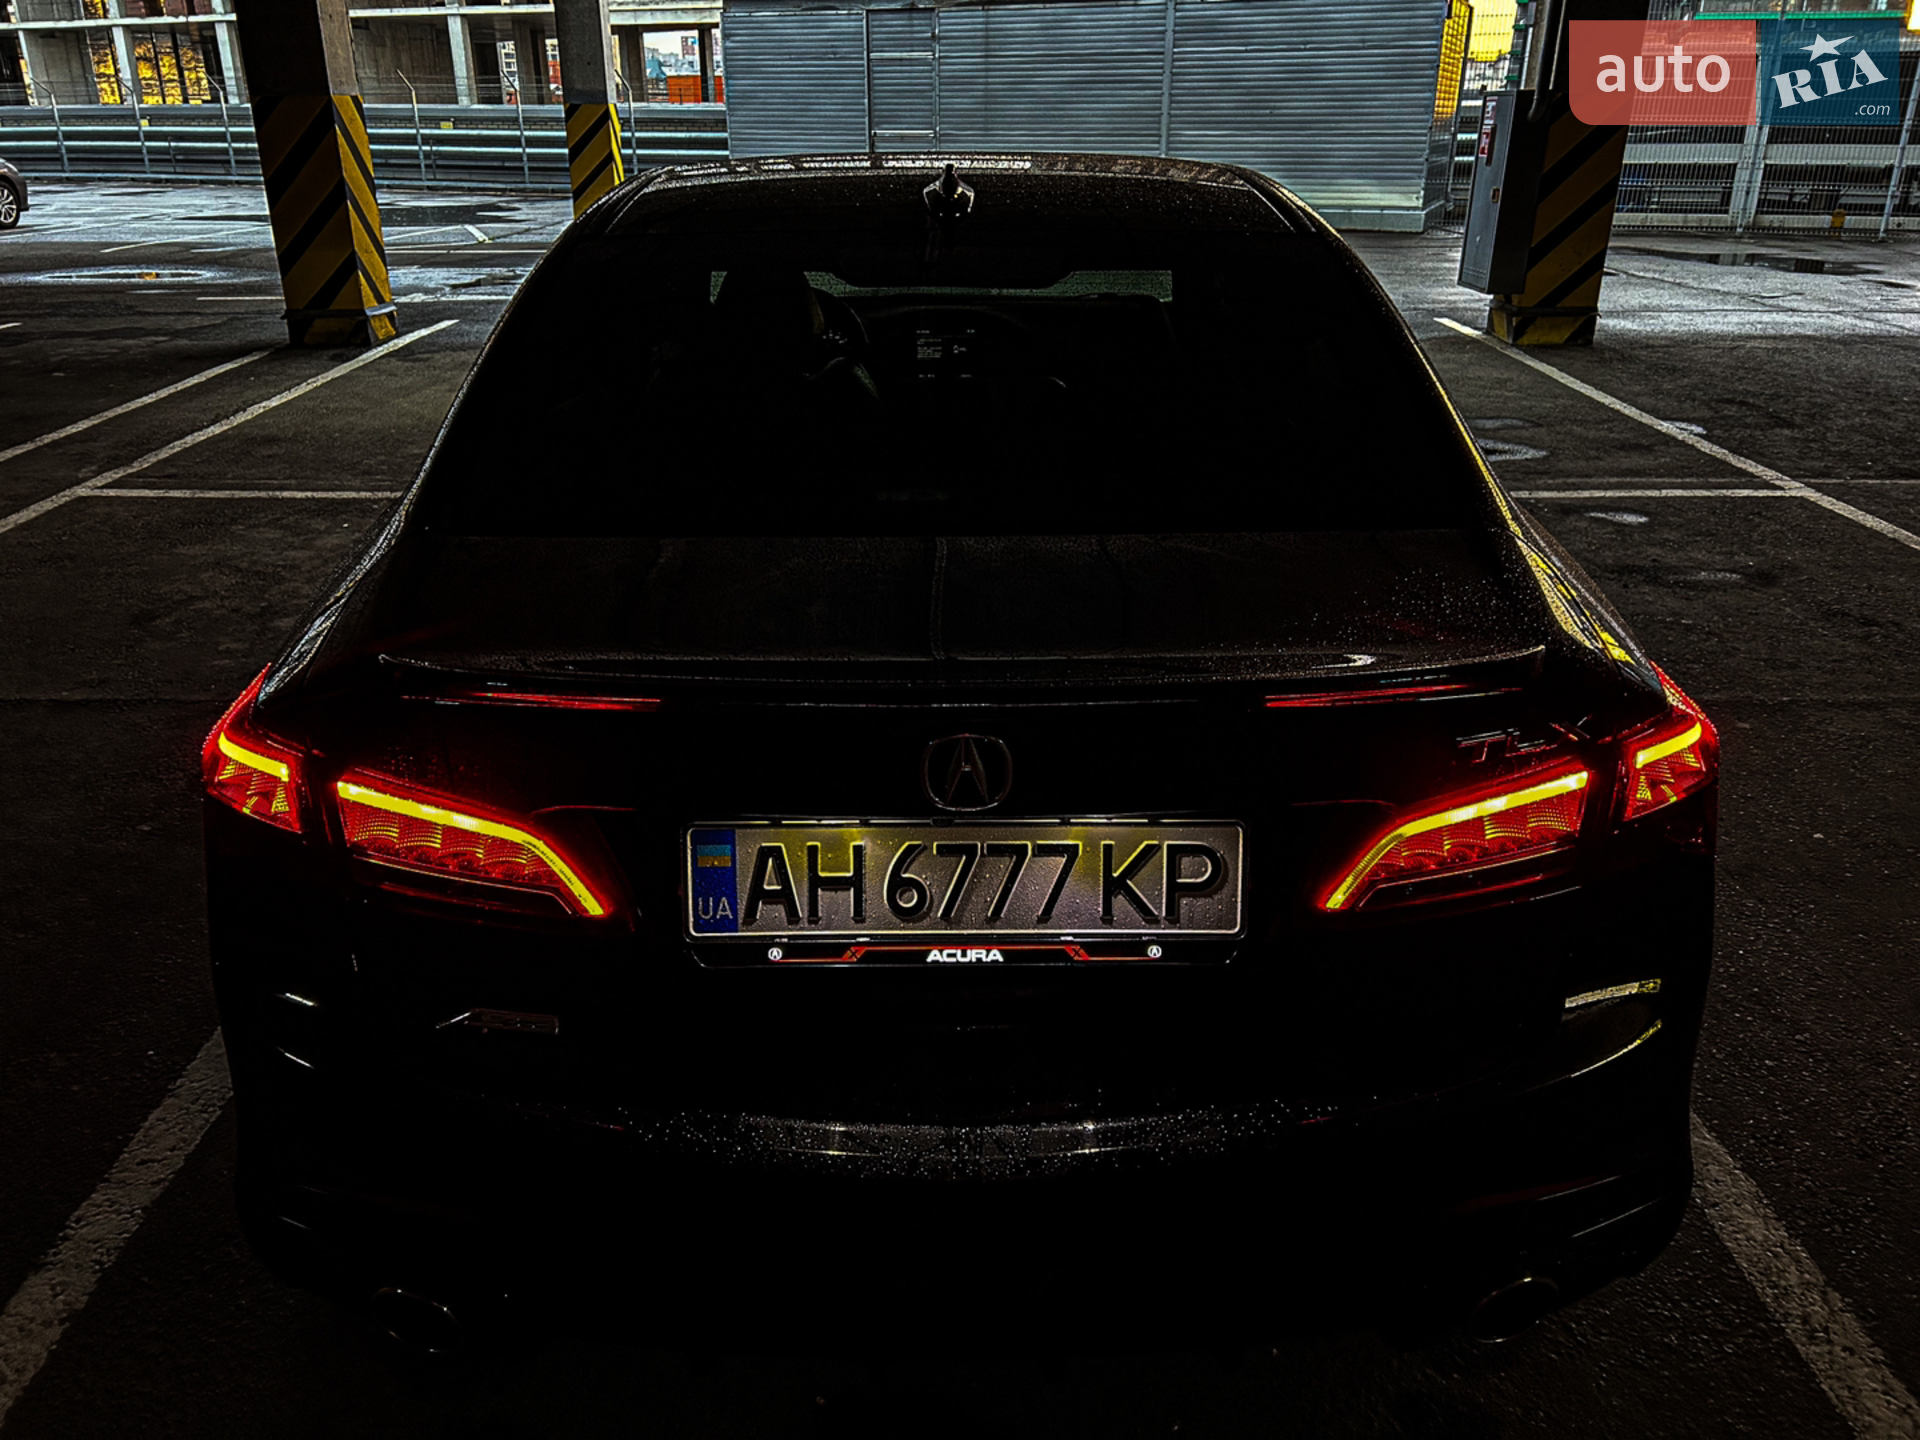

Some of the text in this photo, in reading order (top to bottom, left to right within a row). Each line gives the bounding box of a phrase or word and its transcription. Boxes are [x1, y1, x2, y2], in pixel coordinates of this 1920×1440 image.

[743, 841, 1226, 924] AH 6777 KP
[697, 896, 734, 920] UA
[926, 948, 1004, 963] ACURA
